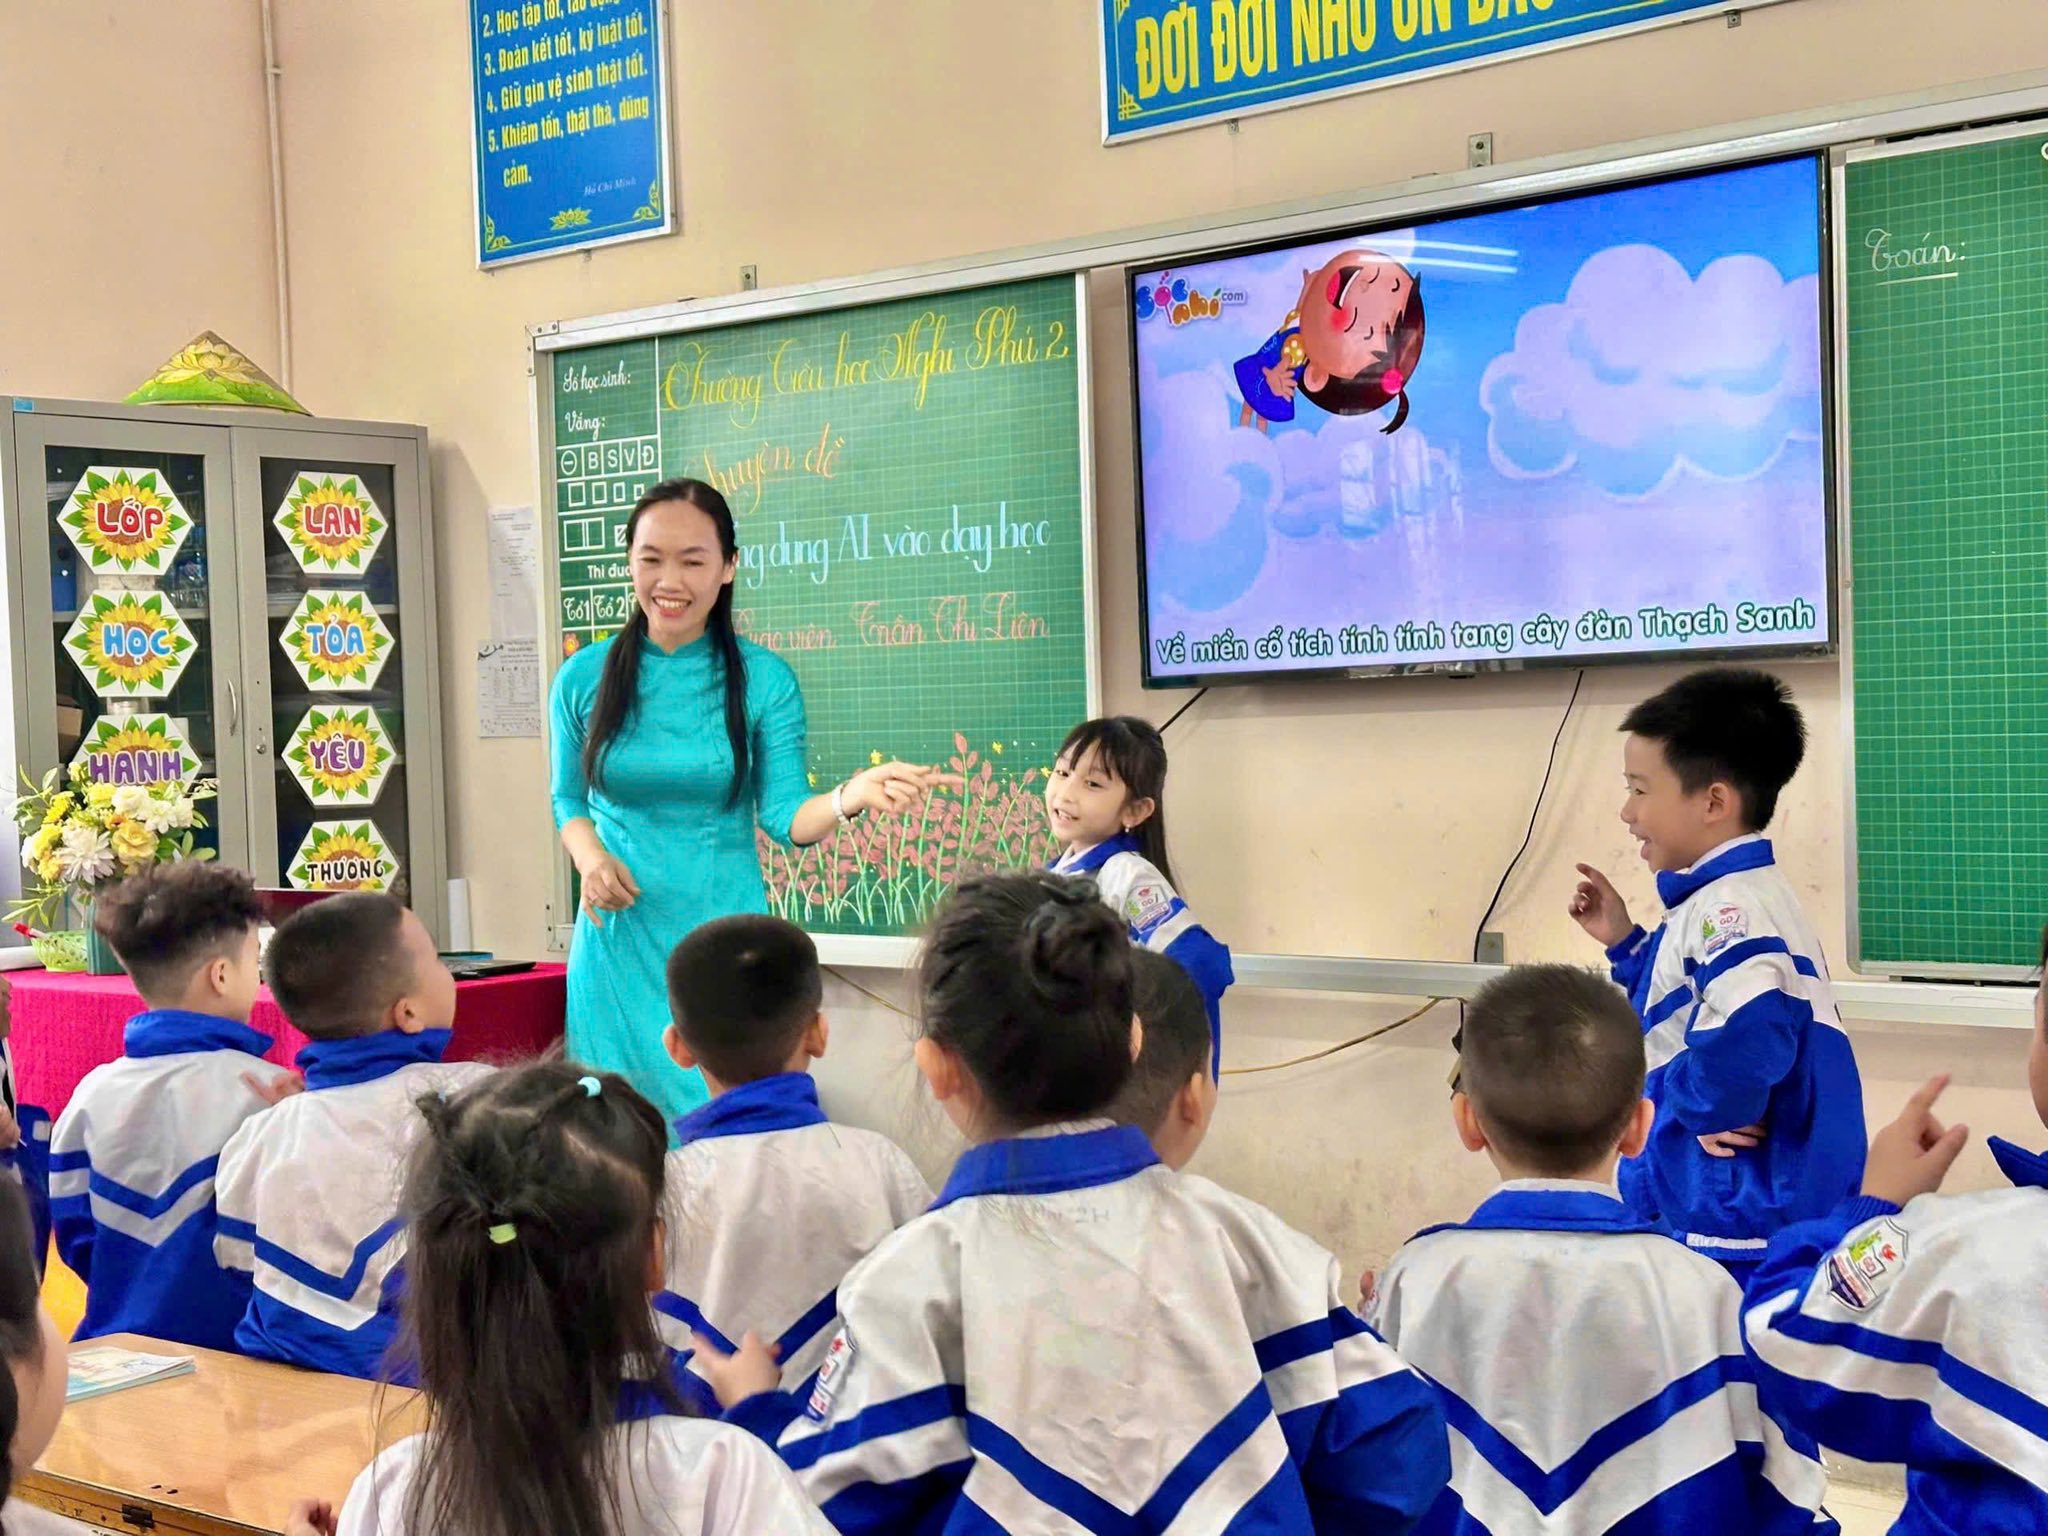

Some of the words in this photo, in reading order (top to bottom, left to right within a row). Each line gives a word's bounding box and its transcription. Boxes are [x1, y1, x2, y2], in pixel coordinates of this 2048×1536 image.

[482, 14, 494, 38] 2.
[496, 9, 519, 37] Học
[522, 1, 541, 31] tập
[484, 52, 496, 76] 3.
[499, 43, 529, 73] Đoàn
[532, 32, 552, 64] kết
[555, 27, 576, 57] tốt,
[597, 18, 622, 48] luật
[626, 8, 647, 38] tốt.
[486, 91, 498, 113] 4.
[501, 81, 521, 111] Giữ
[548, 72, 562, 102] vệ
[566, 66, 593, 95] sinh
[597, 58, 622, 88] thật
[625, 49, 648, 79] tốt.
[487, 129, 499, 152] 5.
[501, 120, 538, 149] Khiêm
[541, 110, 564, 140] tốn,
[566, 106, 590, 136] thật
[593, 100, 616, 126] thà,
[619, 95, 649, 121] dũng
[503, 159, 532, 188] cảm.
[1864, 228, 1966, 271] Toán:
[1046, 320, 1069, 360] 2
[581, 365, 599, 394] học
[600, 360, 631, 387] sinh:
[564, 410, 605, 441] Vắng:
[95, 497, 164, 540] LỚP
[304, 504, 362, 538] LAN
[734, 521, 764, 590] ng
[769, 521, 829, 585] dụng
[838, 512, 874, 563] AI
[884, 525, 931, 558] vào
[941, 504, 992, 573] dạy
[1000, 501, 1051, 555] học
[587, 564, 605, 579] Thi
[563, 597, 583, 621] Tổ
[593, 594, 613, 618] Tổ
[616, 596, 625, 617] 2
[102, 622, 172, 666] HỌC
[306, 613, 366, 656] TỎA
[1156, 631, 1186, 664] Về
[1191, 628, 1249, 663] miền
[1254, 625, 1283, 659] cổ
[1289, 627, 1333, 657] tích
[1339, 623, 1388, 655] tính
[1395, 621, 1445, 652] tính
[1451, 621, 1513, 652] tang
[1521, 613, 1569, 650] cây
[1576, 608, 1631, 641] đàn
[1638, 603, 1727, 642] Thạch
[1735, 597, 1815, 632] Sanh
[309, 731, 366, 770] YÊU
[306, 856, 385, 882] THƯƠNG
